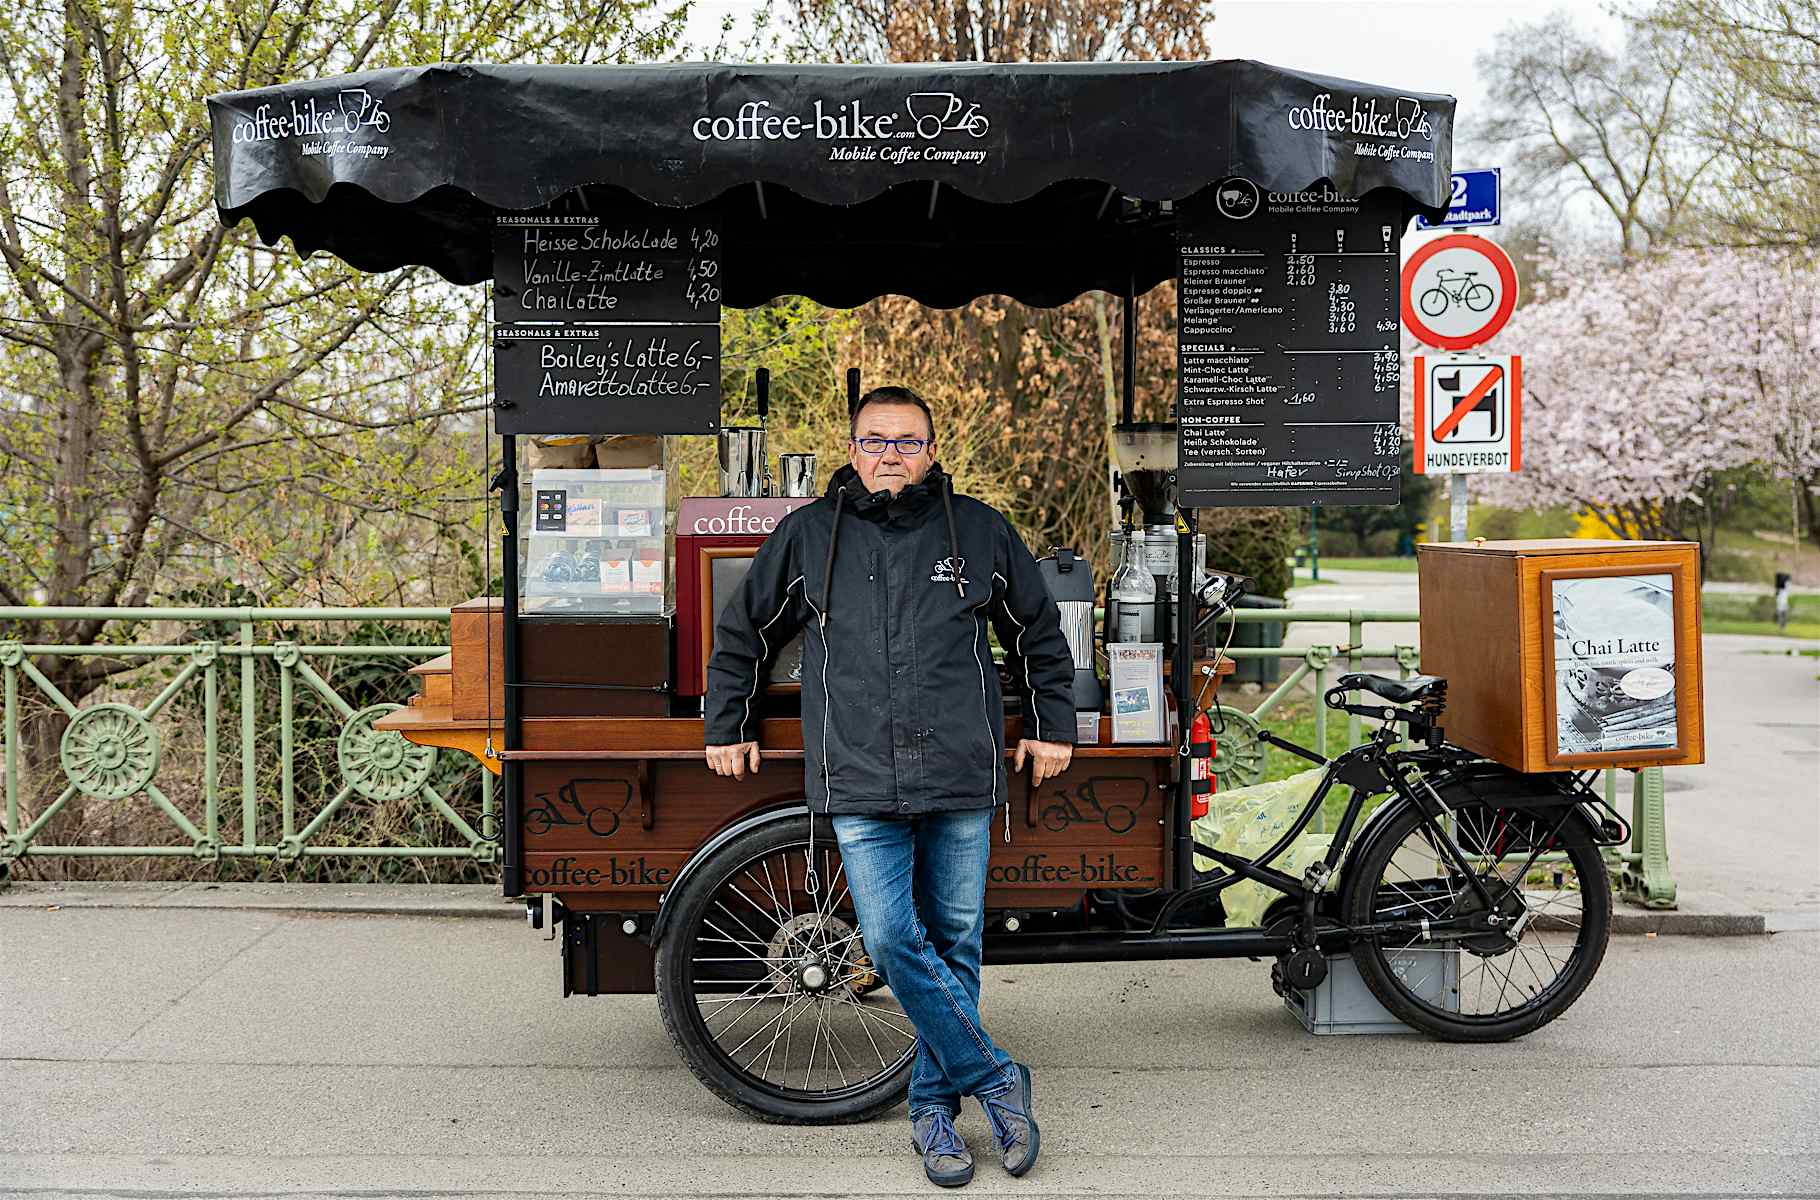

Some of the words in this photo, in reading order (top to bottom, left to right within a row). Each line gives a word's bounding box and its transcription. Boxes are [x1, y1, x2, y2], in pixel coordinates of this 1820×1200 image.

[302, 141, 322, 156] Mobile
[322, 140, 345, 158] Coffee
[346, 141, 389, 159] Company
[1354, 142, 1377, 157] Mobile
[1377, 144, 1400, 160] Coffee
[829, 147, 877, 161] Mobile
[880, 147, 921, 164] Coffee
[924, 147, 986, 164] Company
[1268, 186, 1360, 203] coffee-bi
[1268, 205, 1293, 213] Mobile
[1295, 205, 1320, 213] Coffee
[1322, 206, 1359, 214] Company
[496, 216, 550, 224] SEASONALS
[563, 216, 599, 224] EXTRAS
[524, 229, 578, 253] Heisse
[691, 227, 719, 252] 4,20
[1183, 258, 1220, 266] Espresso
[687, 258, 718, 281] 4,50
[1183, 268, 1220, 276] Espresso
[1222, 267, 1265, 275] macchiato
[1183, 277, 1212, 285] Kleiner
[1214, 277, 1246, 285] Brauner
[686, 283, 720, 309] 4,20
[1183, 288, 1220, 296] Espresso
[1222, 287, 1252, 296] doppio
[1183, 297, 1212, 305] Großer
[1214, 297, 1246, 305] Brauner
[1183, 316, 1219, 325] Melange
[496, 329, 550, 337] SEASONALS
[563, 329, 600, 337] EXTRAS
[1183, 325, 1233, 334] Cappuccino
[1181, 344, 1225, 352] SPECIALS
[624, 338, 679, 368] Latte
[1207, 356, 1249, 364] macchiato
[1183, 366, 1226, 374] Mint-Choc
[1228, 366, 1249, 374] Latte
[1183, 376, 1243, 384] Karamell-Choc
[1245, 376, 1267, 384] Latte
[1183, 385, 1254, 394] Schwarzw.-Kirsch
[1256, 385, 1278, 393] Latte
[1183, 398, 1205, 406] Extra
[1207, 398, 1243, 407] Espresso
[1181, 416, 1241, 424] NON-COFFEE
[1183, 429, 1203, 437] Chai
[1204, 429, 1226, 437] Latte
[1183, 438, 1208, 446] Heiße
[1210, 438, 1257, 446] Schokolade
[1183, 448, 1199, 456] Tee
[1201, 447, 1234, 457] (versch.
[1235, 447, 1266, 457] Sorten)
[1427, 452, 1509, 467] HUNDEVERBOT
[1267, 466, 1309, 478] Hafer
[694, 505, 792, 534] coffee
[1572, 639, 1612, 656] Chai
[1616, 638, 1660, 654] Latte
